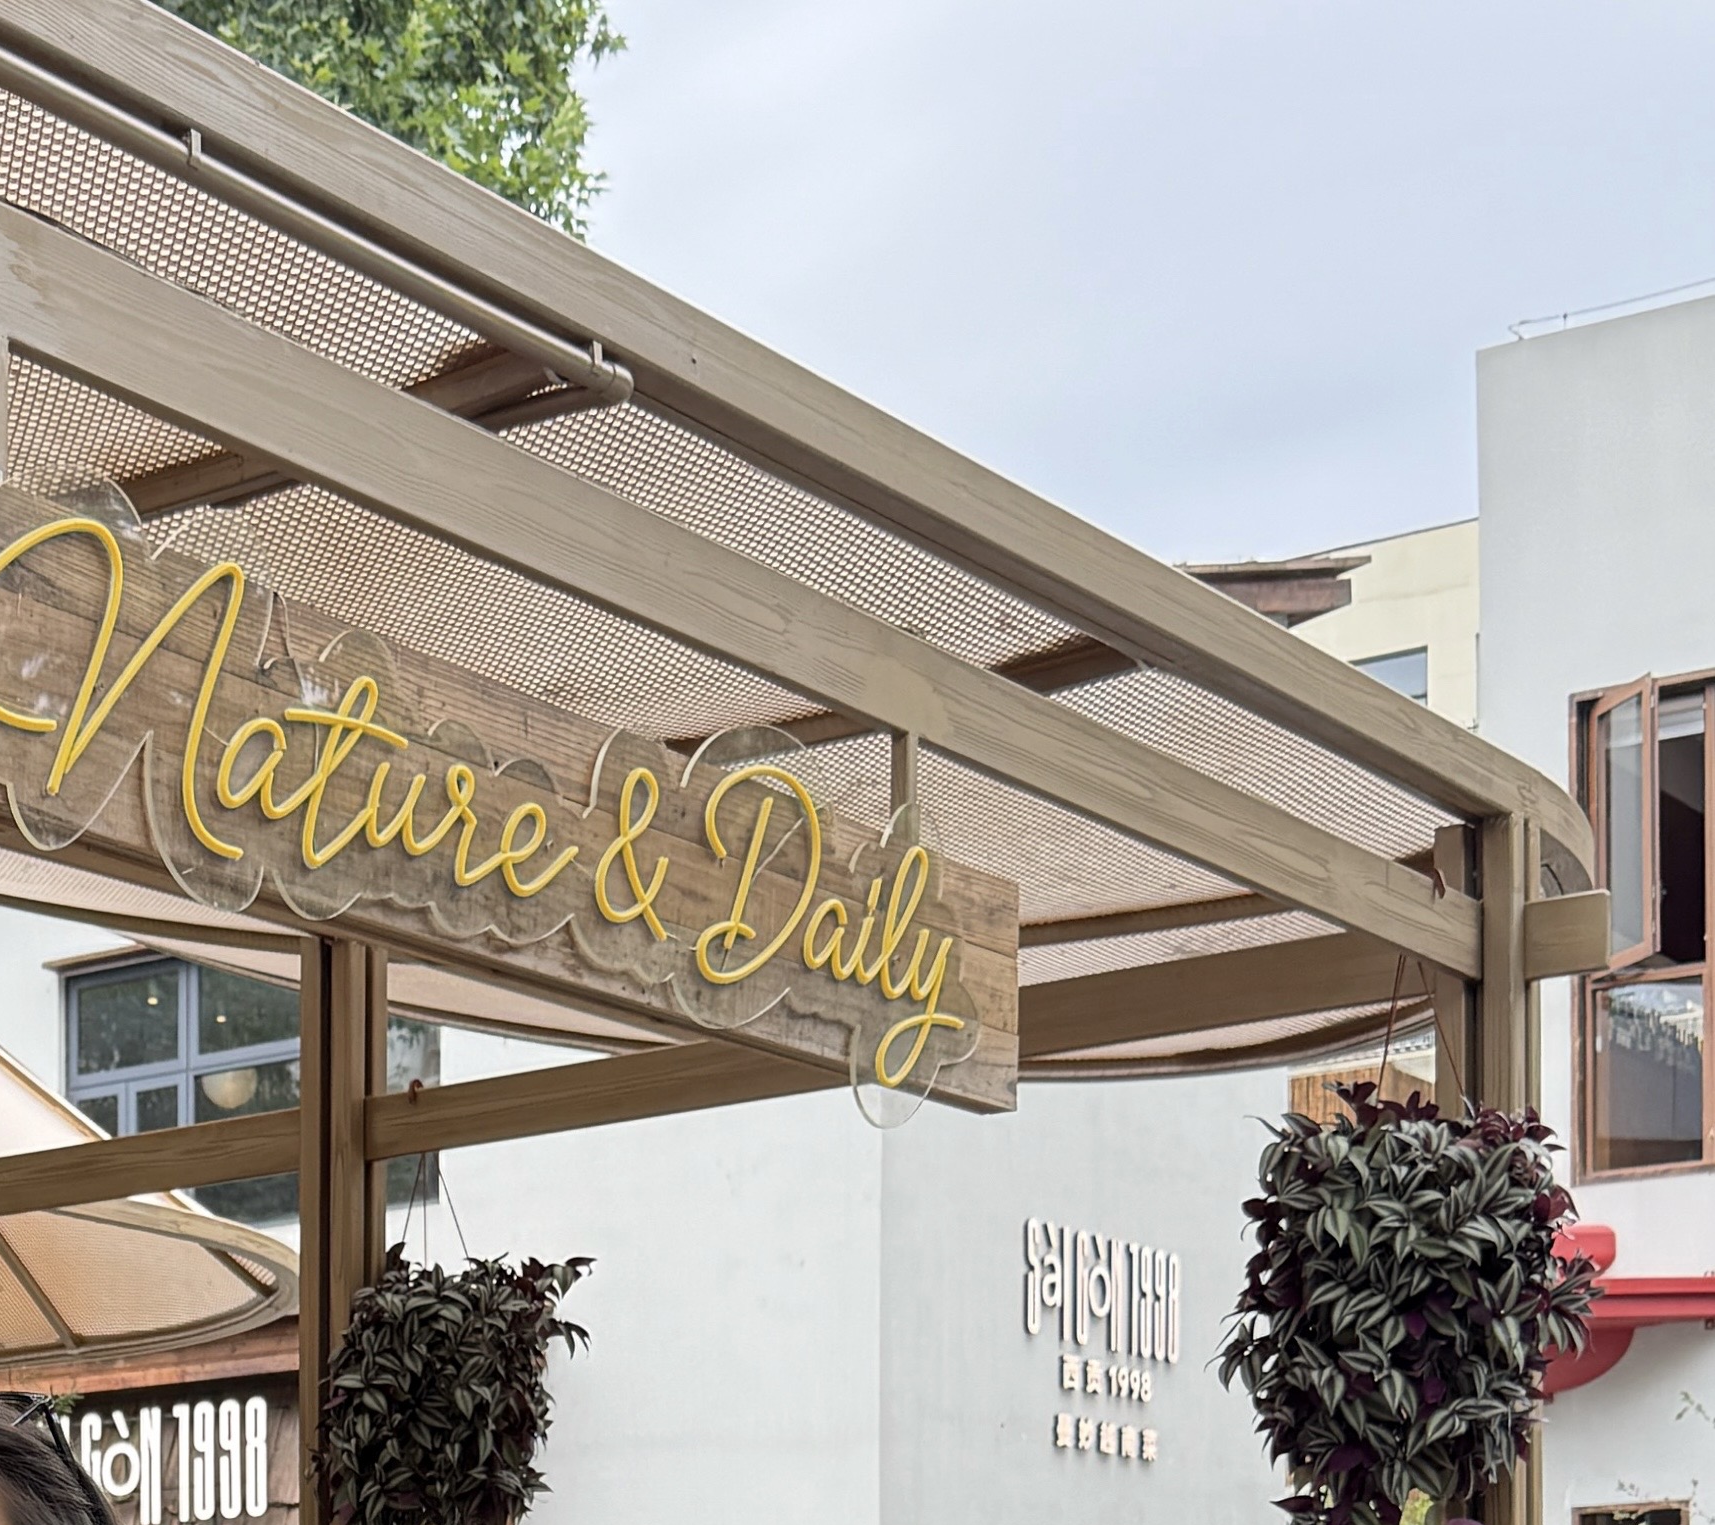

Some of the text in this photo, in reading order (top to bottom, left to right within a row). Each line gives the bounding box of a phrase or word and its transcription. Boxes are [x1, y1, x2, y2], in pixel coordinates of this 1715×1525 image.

[593, 767, 671, 942] &
[695, 763, 966, 1088] Daily
[1128, 1241, 1181, 1364] 1998
[172, 1395, 268, 1523] 1998
